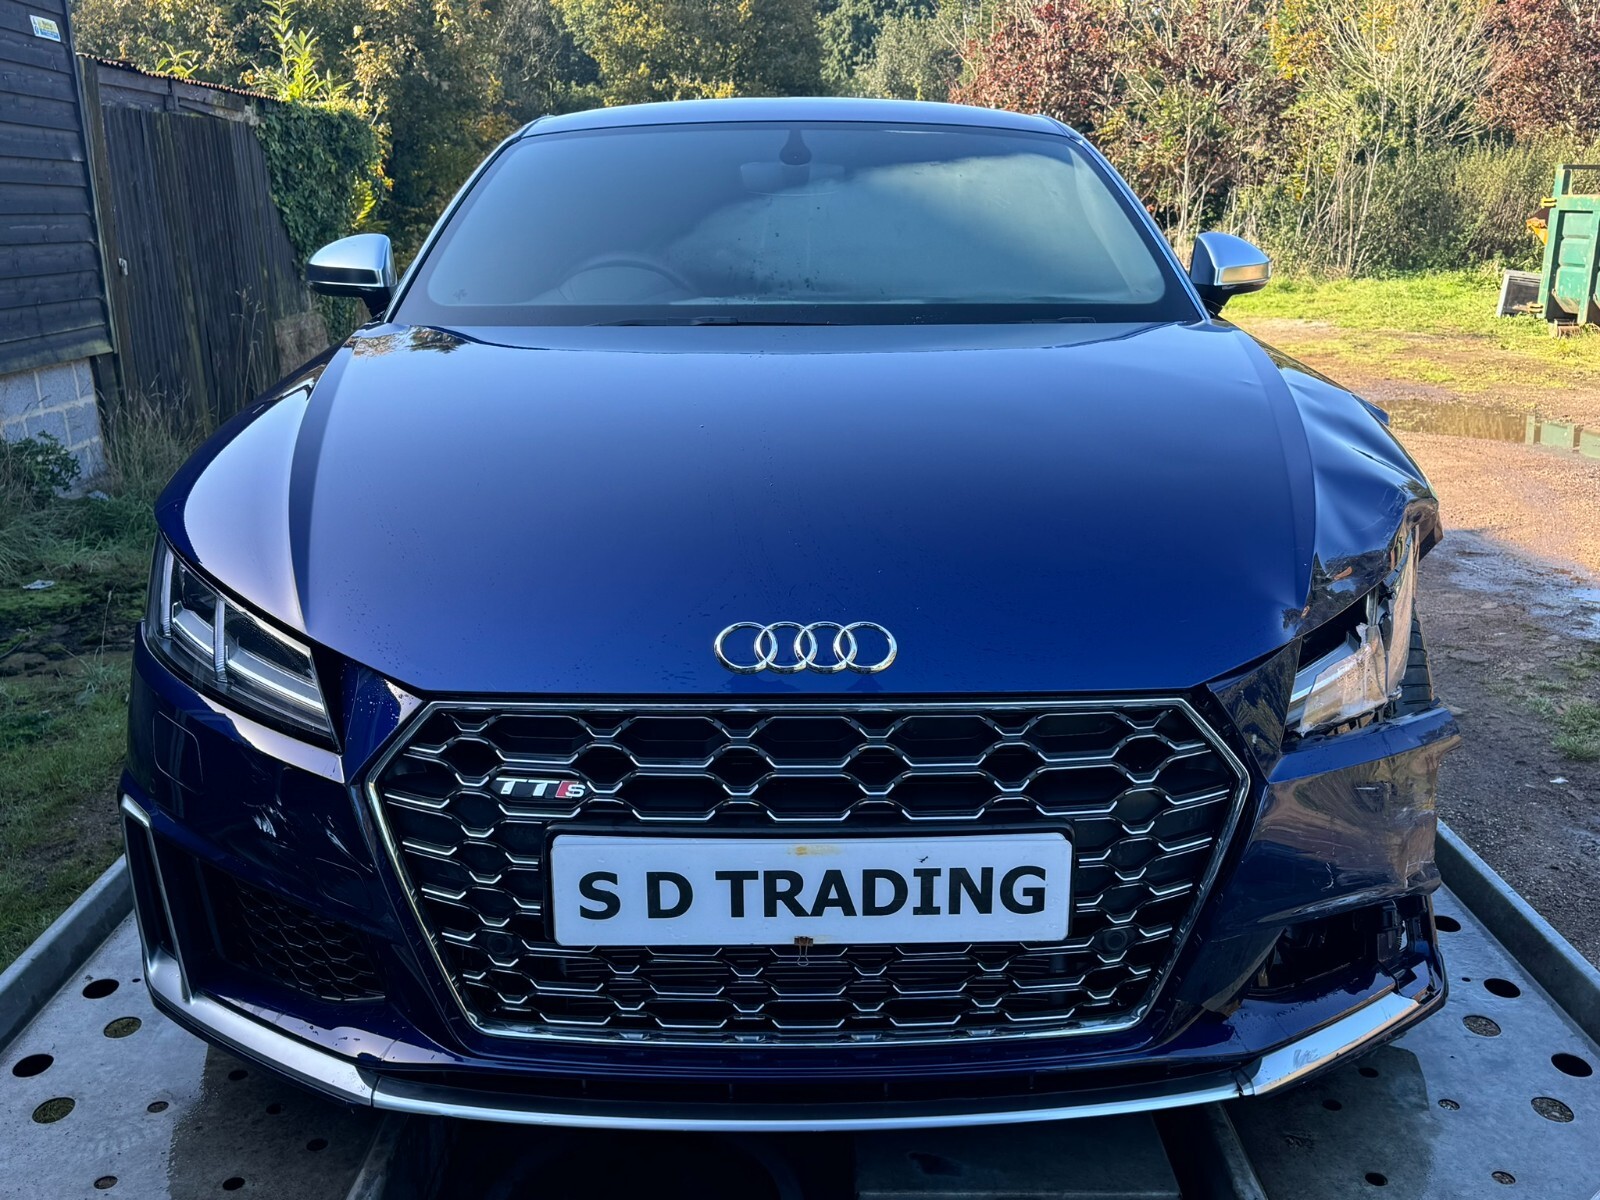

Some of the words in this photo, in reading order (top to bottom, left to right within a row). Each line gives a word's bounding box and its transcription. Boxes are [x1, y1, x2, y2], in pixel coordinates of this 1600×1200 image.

[578, 870, 621, 921] S
[645, 871, 694, 919] D
[714, 865, 1047, 919] TRADING
